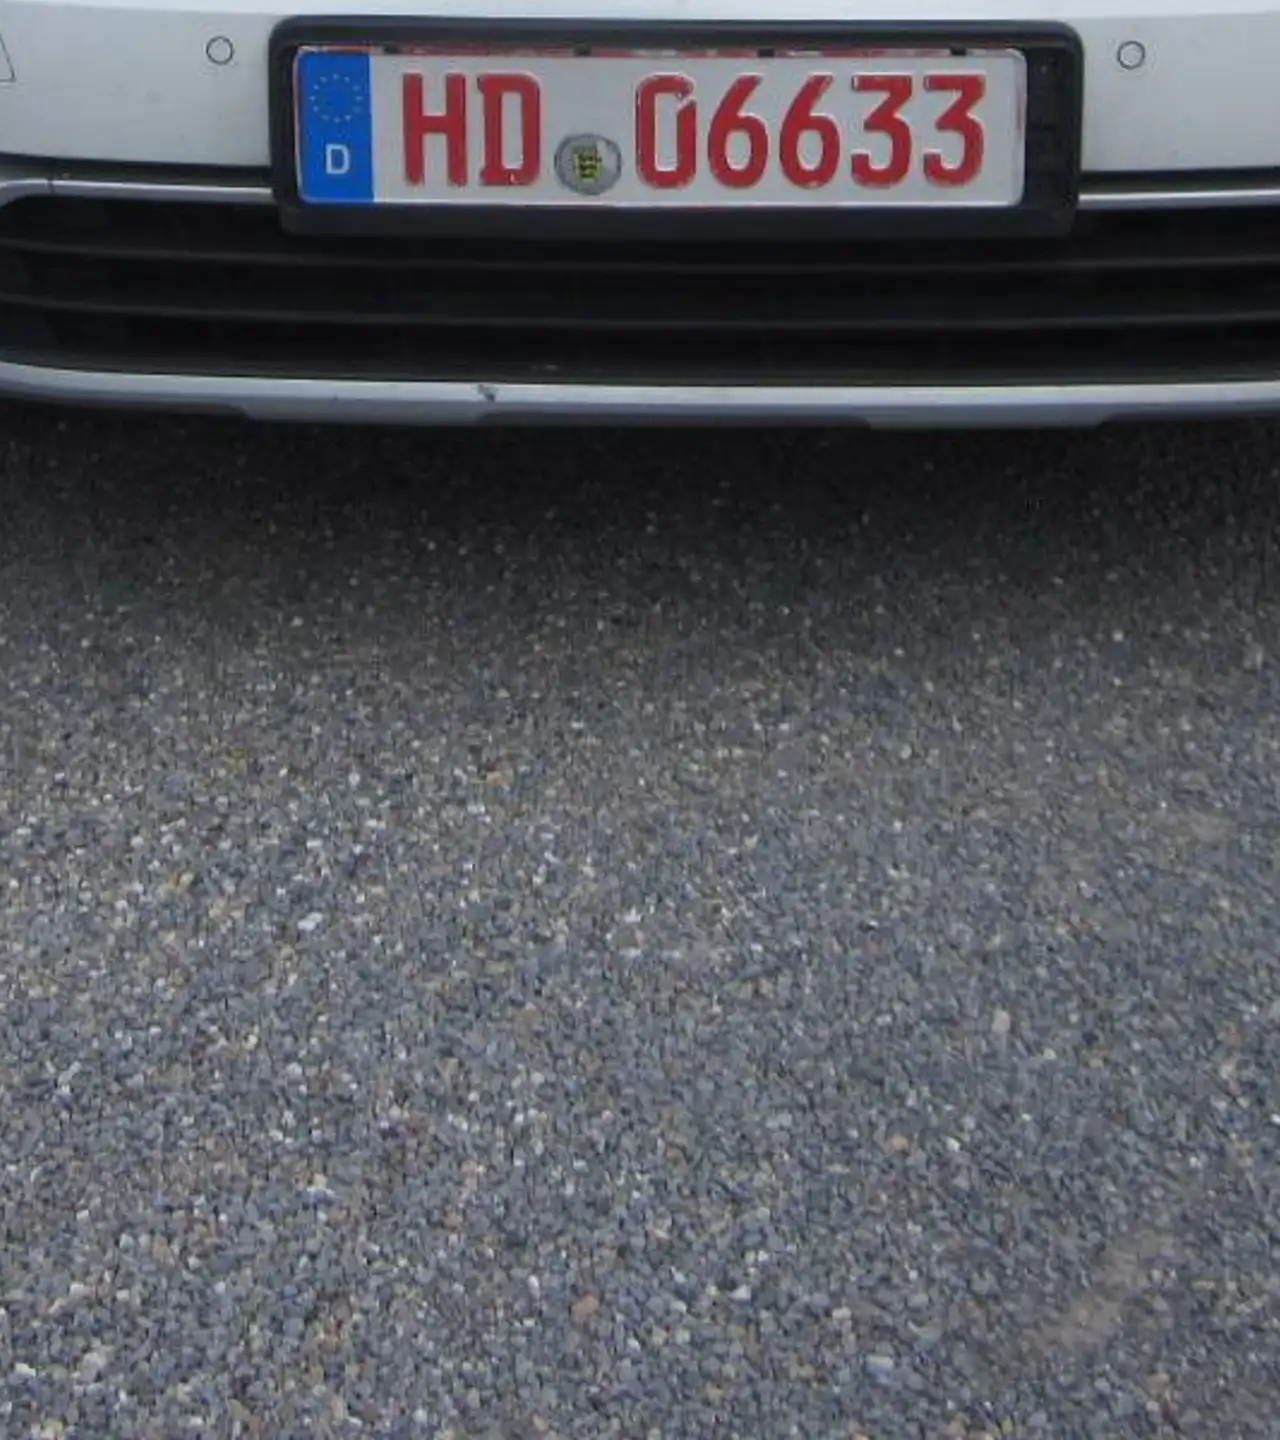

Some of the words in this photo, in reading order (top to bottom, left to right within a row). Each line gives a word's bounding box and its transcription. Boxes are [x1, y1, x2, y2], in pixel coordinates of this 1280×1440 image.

[325, 143, 350, 175] D
[402, 73, 541, 186] HD
[635, 73, 986, 188] 06633
